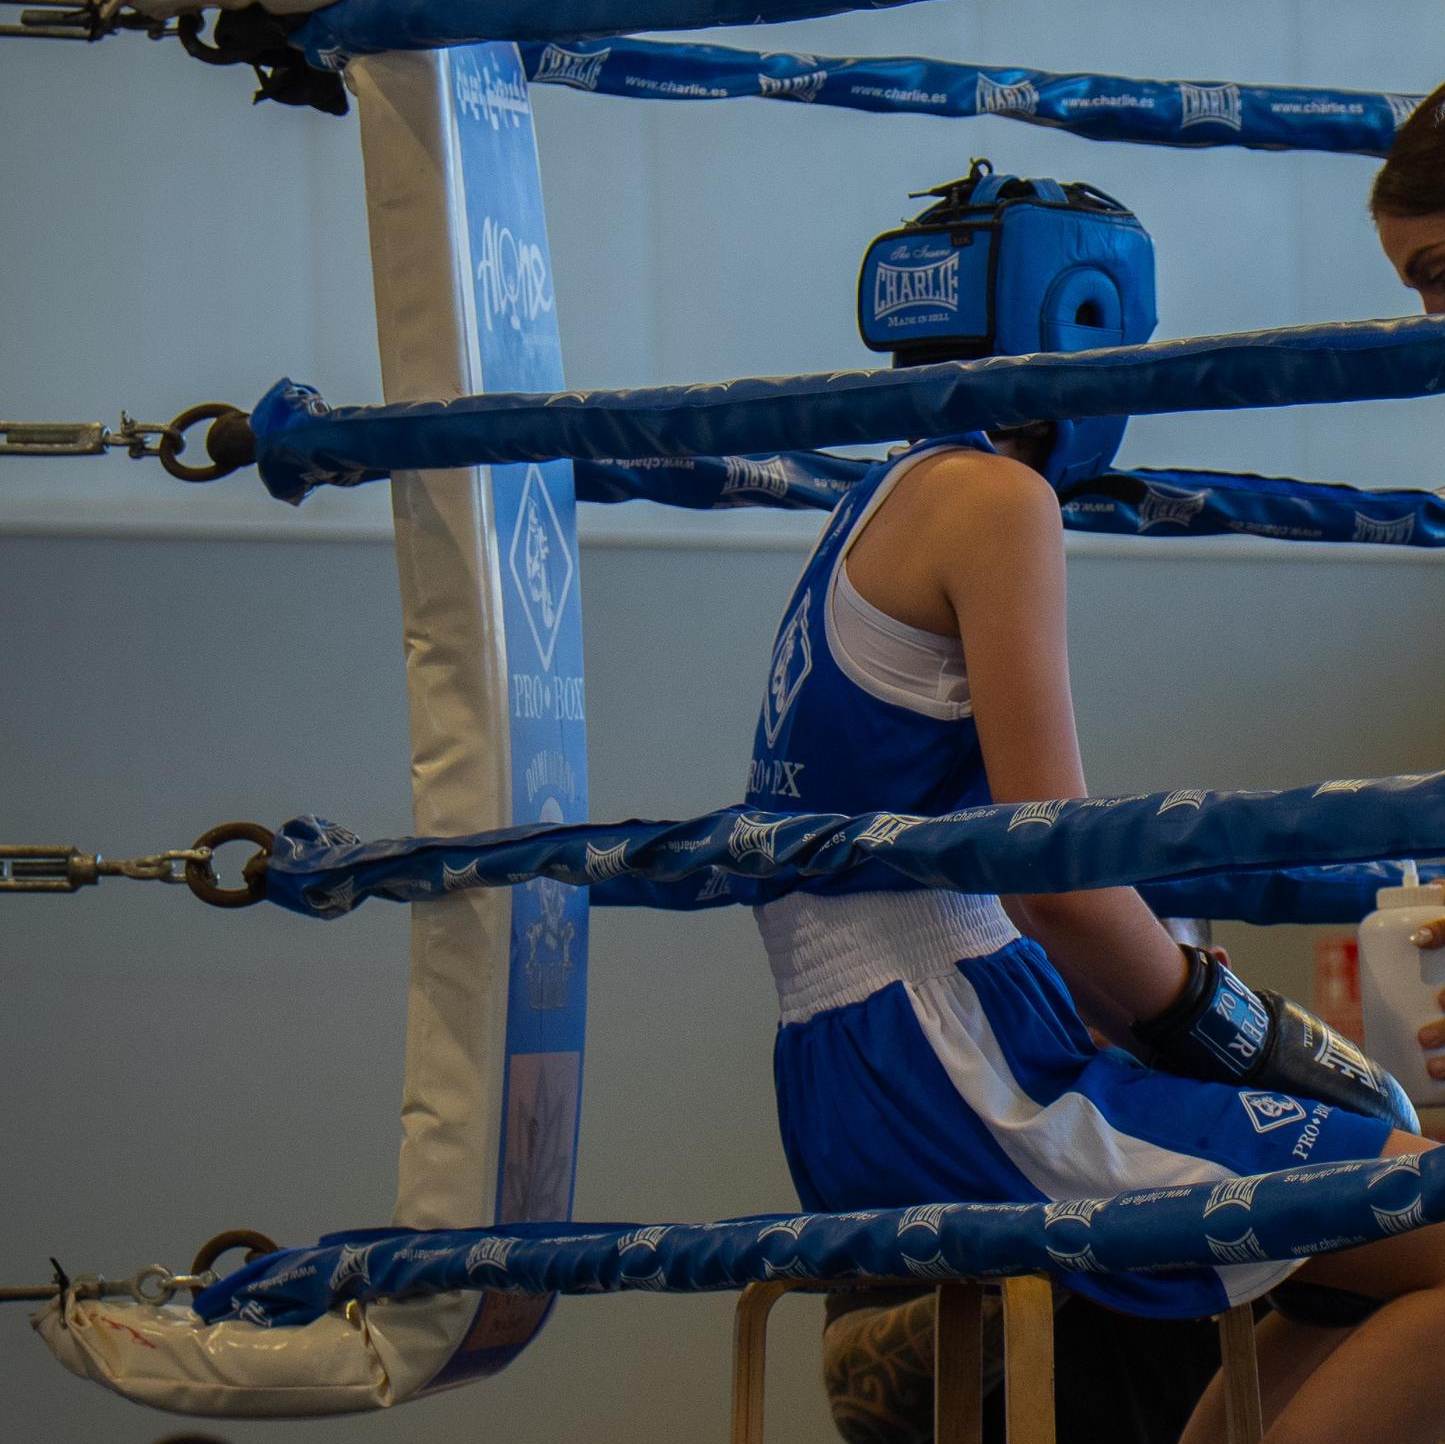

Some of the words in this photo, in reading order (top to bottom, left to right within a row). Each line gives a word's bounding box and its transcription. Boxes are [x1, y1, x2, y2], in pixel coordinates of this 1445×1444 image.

[625, 74, 728, 97] www.charlie.es
[850, 83, 948, 105] www.charlie.es
[1060, 93, 1155, 110] www.charlie.es
[1178, 81, 1242, 132] CHARLIE
[1270, 99, 1364, 116] www.charlie.es
[874, 252, 960, 319] CHARLIE
[513, 673, 543, 720] PRO
[553, 676, 585, 722] BOX
[1292, 1123, 1321, 1160] PRO
[1203, 1174, 1270, 1219] CHARLIE
[1284, 1163, 1363, 1185] www.charlie.es
[1119, 1188, 1191, 1206] www.charlie.es
